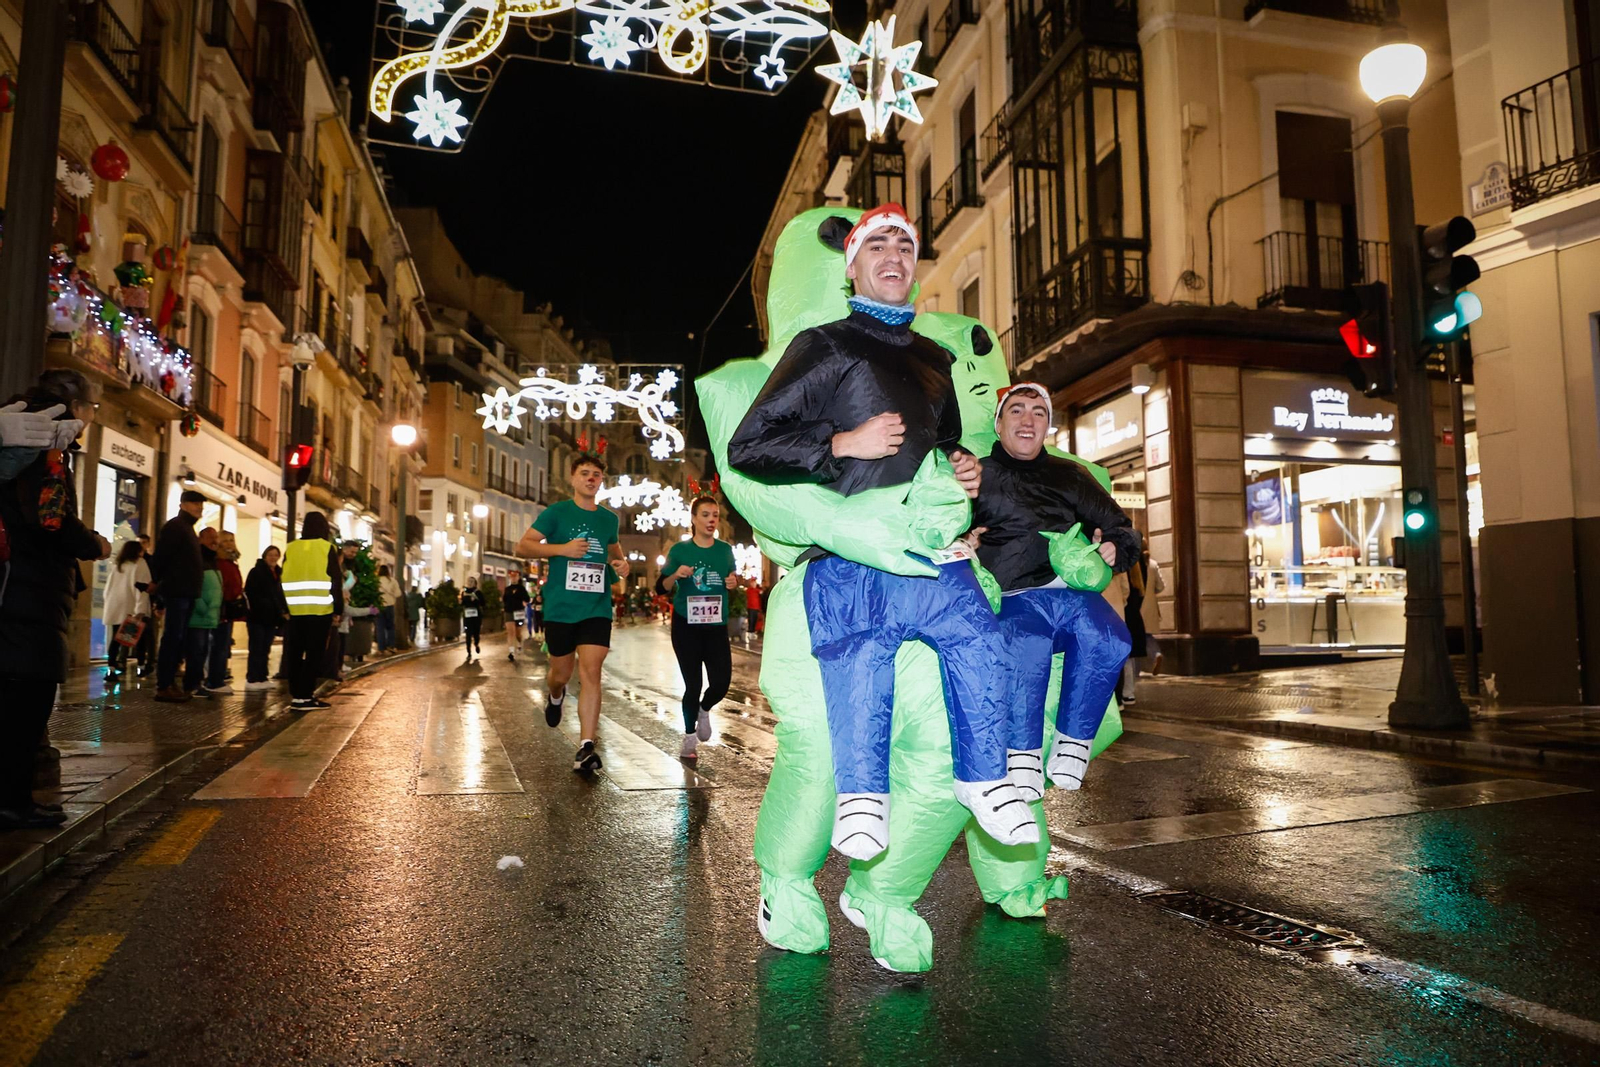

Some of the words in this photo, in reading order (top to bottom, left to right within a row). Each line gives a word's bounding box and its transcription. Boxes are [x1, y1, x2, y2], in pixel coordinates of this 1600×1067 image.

[1273, 406, 1309, 432] Rey
[1314, 412, 1394, 432] Fernando
[111, 443, 146, 468] exchange
[217, 462, 251, 492] ZARA
[252, 480, 280, 506] HOME
[571, 572, 601, 584] 2113
[692, 605, 719, 616] 2112
